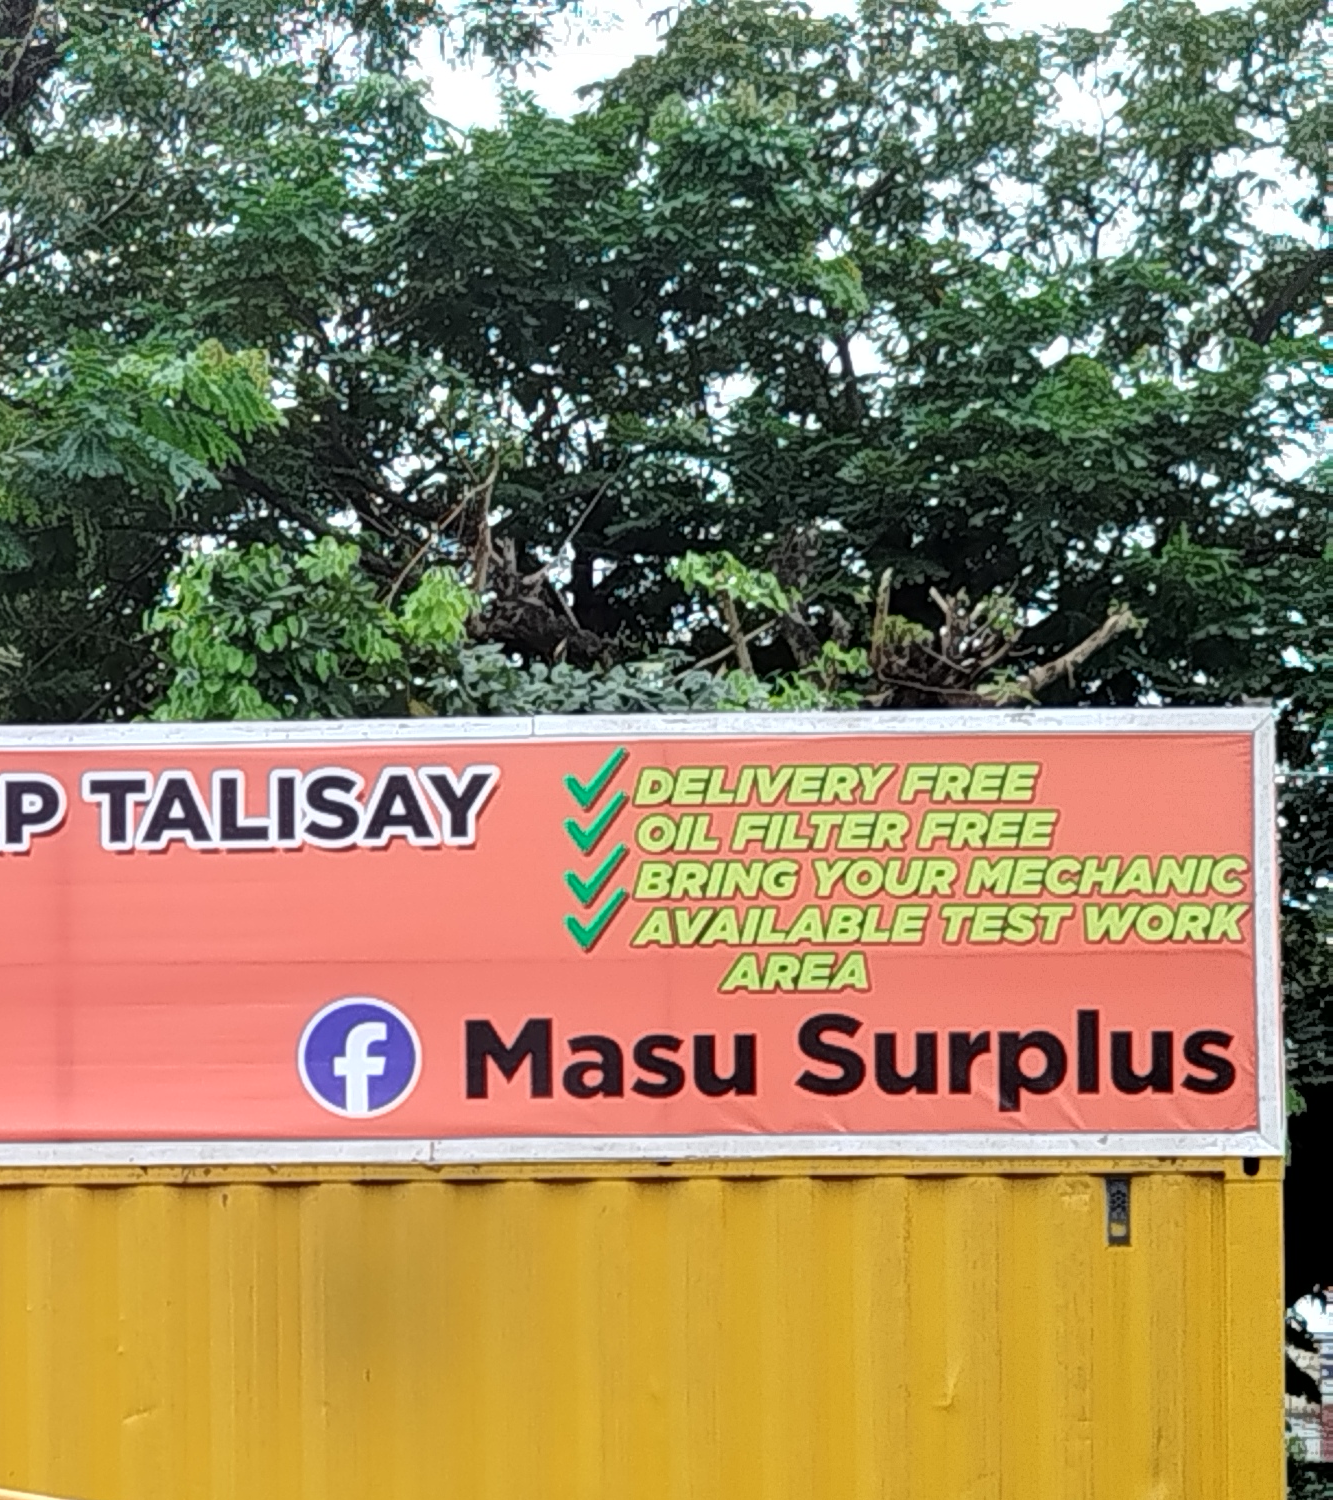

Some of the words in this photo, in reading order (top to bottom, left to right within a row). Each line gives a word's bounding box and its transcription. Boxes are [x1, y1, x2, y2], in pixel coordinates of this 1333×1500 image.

[636, 766, 897, 803] DELIVERY
[901, 764, 1038, 801] FREE
[87, 768, 499, 846] TALISAY
[636, 814, 719, 852] OIL
[734, 813, 908, 850] FILTER
[918, 812, 1057, 848] FREE
[635, 861, 798, 899] BRING
[814, 859, 960, 897] YOUR
[967, 857, 1248, 894] MECHANIC
[634, 907, 927, 945] AVAILABLE
[942, 907, 1075, 943] TEST
[1086, 905, 1249, 942] WORK
[720, 955, 869, 991] AREA
[464, 1018, 757, 1098] Masu
[795, 1009, 1235, 1112] Surplus
